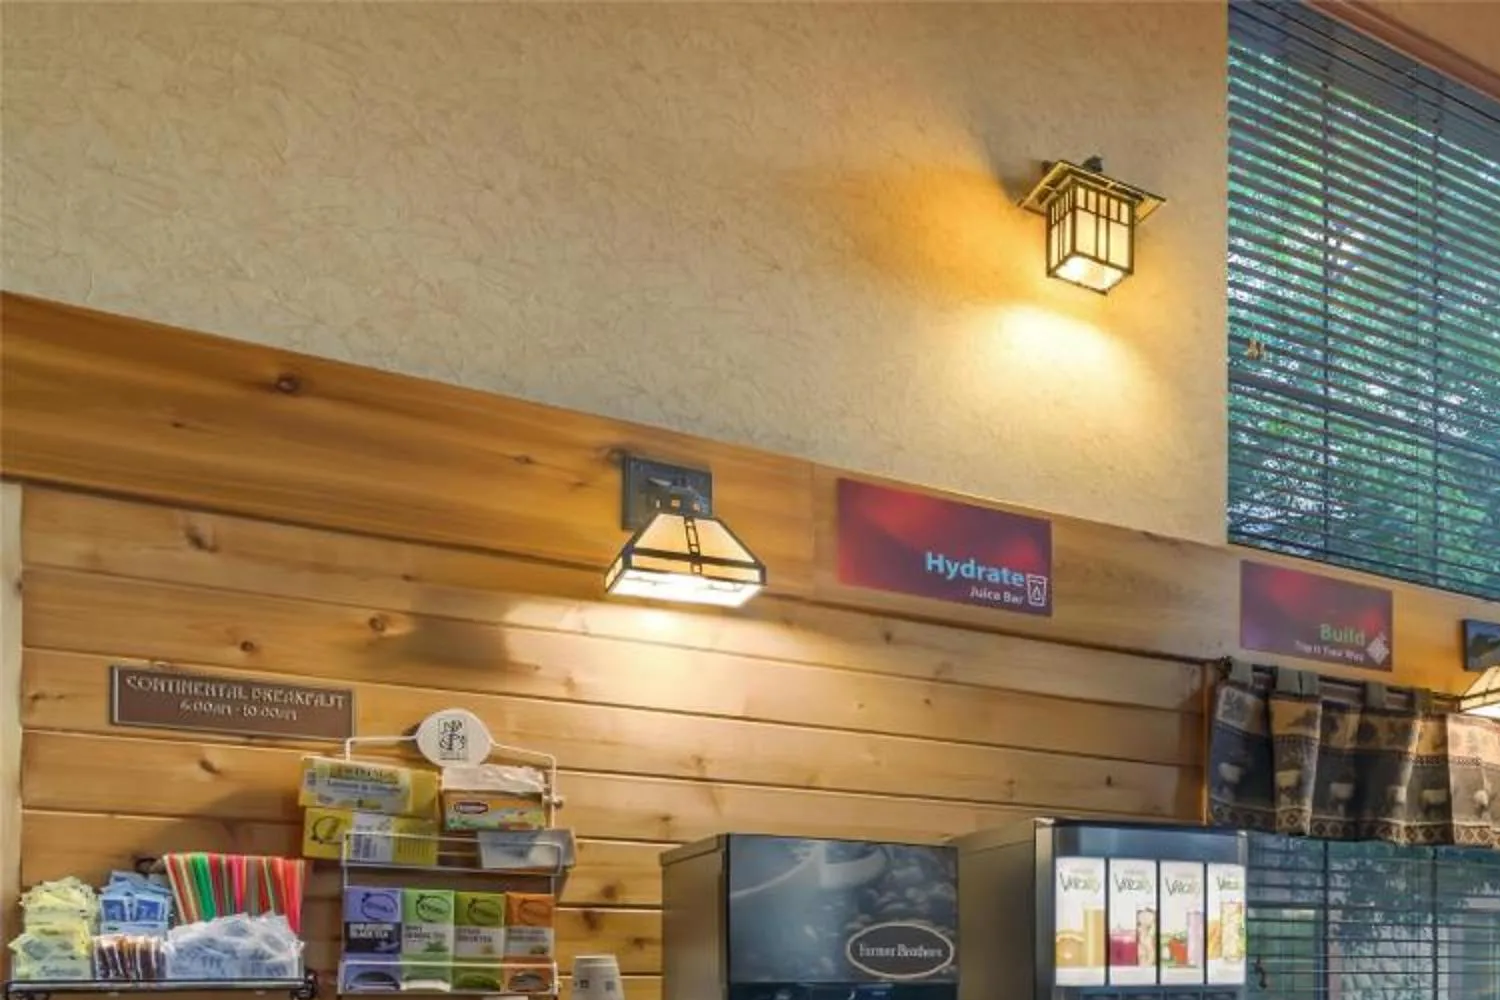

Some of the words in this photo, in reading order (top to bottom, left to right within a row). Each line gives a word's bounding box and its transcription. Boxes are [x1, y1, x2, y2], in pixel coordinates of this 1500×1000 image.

[925, 552, 1025, 587] Hydrate
[969, 585, 1000, 601] Juice
[1003, 590, 1024, 605] Bar
[1319, 623, 1366, 647] Build
[126, 673, 247, 700] CONTINENTAL
[251, 689, 345, 711] BREAKFAST
